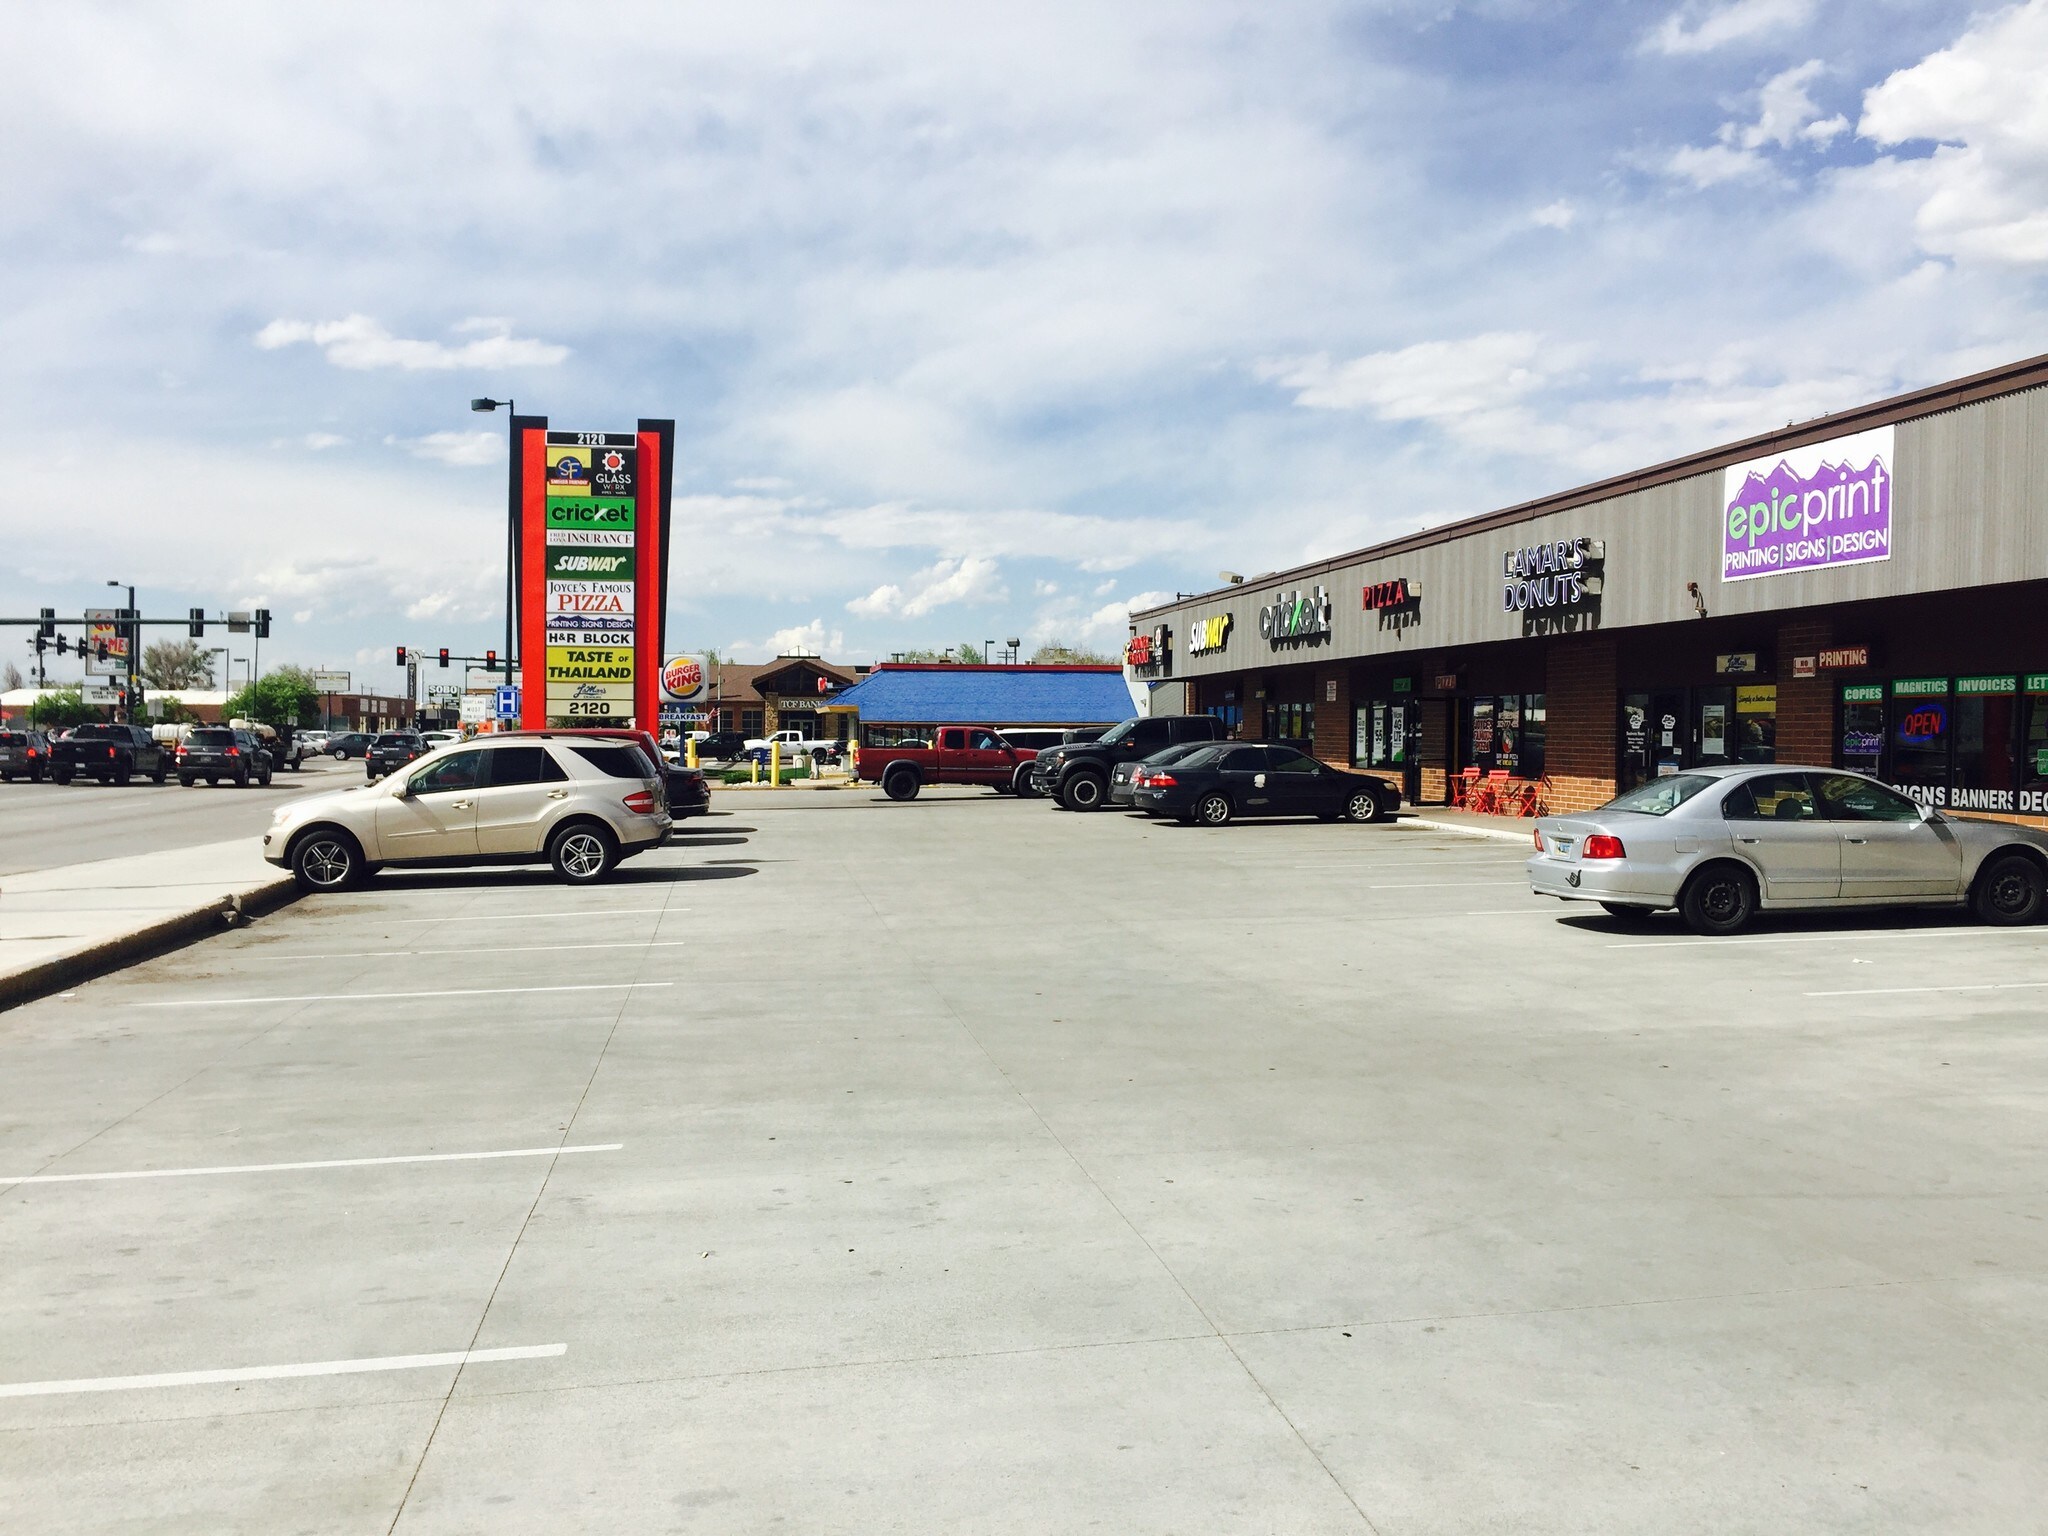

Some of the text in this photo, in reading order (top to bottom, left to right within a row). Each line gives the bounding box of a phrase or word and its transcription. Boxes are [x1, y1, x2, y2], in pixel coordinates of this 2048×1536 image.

[577, 433, 606, 445] 2120
[557, 459, 580, 479] SF
[595, 473, 632, 484] GLASS
[551, 503, 629, 522] cricket
[1728, 464, 1885, 547] epicprint
[567, 533, 632, 544] INSURANCE
[1725, 527, 1887, 571] PRINTING SIGNS DESIGN
[553, 555, 627, 572] SUBWAY
[1503, 537, 1584, 580] LAMAR'S
[550, 582, 631, 595] JOYCE'S FAMOUS
[1362, 580, 1405, 611] PIZZA
[1503, 571, 1582, 613] DONUTS
[557, 593, 624, 612] PIZZA
[1259, 585, 1328, 640] cricket
[547, 620, 578, 628] PRINTING
[549, 633, 630, 644] H&R BLOCK
[1189, 613, 1230, 653] SUBWAY
[567, 651, 613, 662] TASTE
[1819, 649, 1868, 667] PRINTING
[548, 666, 631, 678] THAILAND
[665, 663, 700, 680] BURGER
[667, 671, 702, 692] KING
[1895, 680, 1948, 694] MAGNETICS
[1958, 678, 2016, 692] INVOICES
[499, 692, 516, 712] H
[1845, 687, 1882, 700] COPIES
[569, 702, 610, 715] 2120
[781, 700, 798, 708] TCF
[1904, 712, 1942, 736] OPEN
[1845, 736, 1879, 748] epicprint
